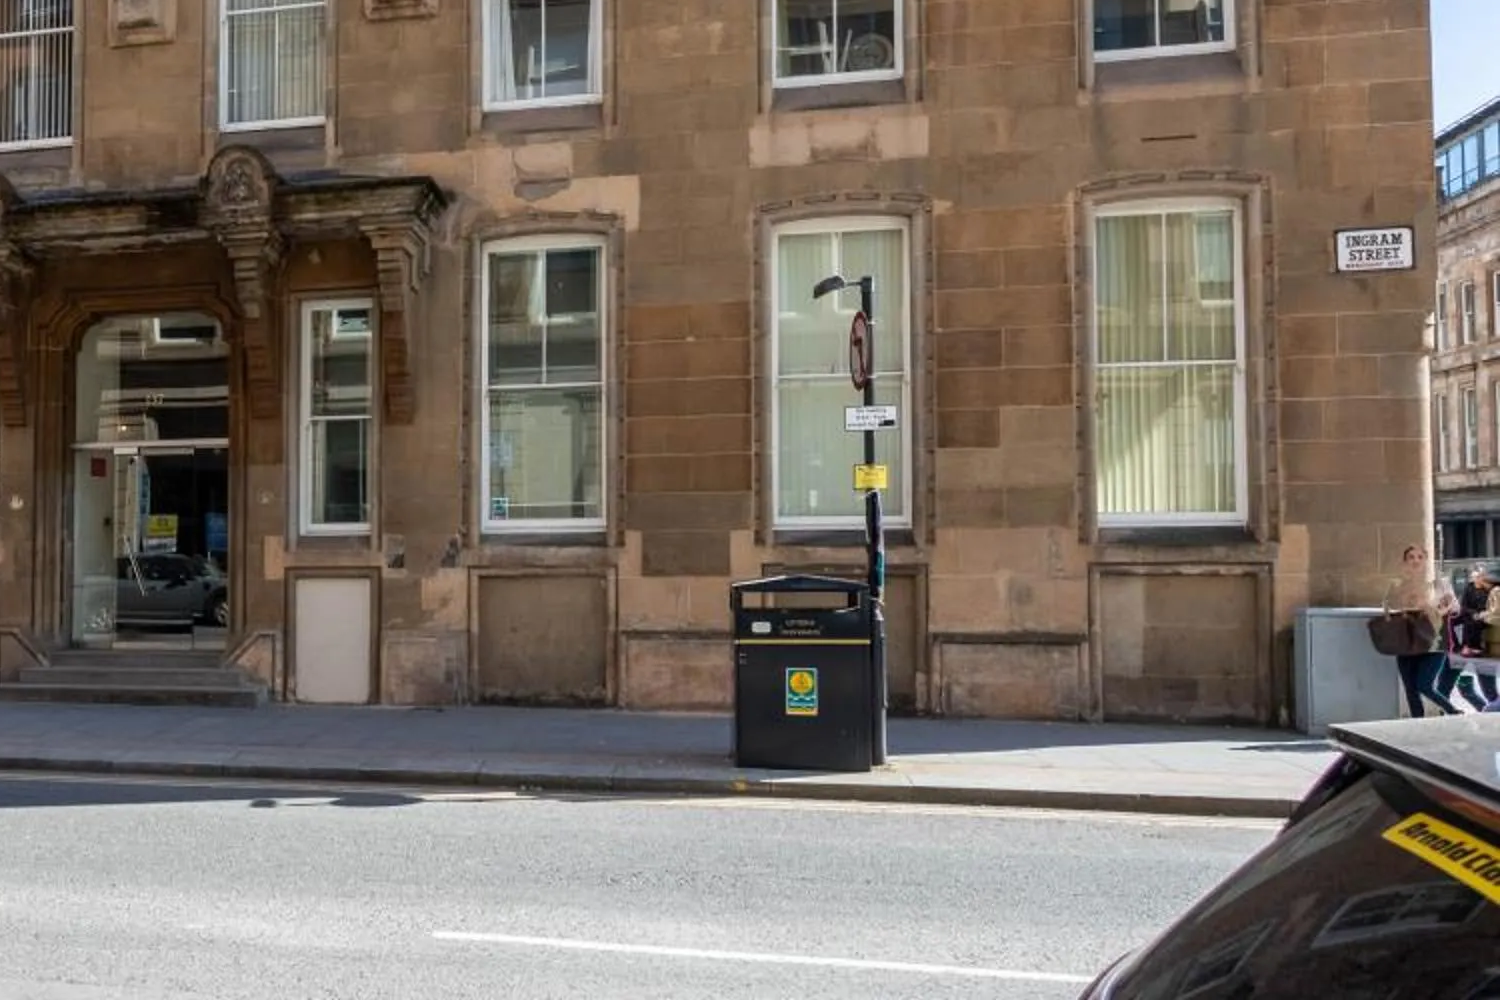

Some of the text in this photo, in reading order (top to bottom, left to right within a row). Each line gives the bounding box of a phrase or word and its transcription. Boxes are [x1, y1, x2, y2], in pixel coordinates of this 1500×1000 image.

[1345, 233, 1403, 247] INGRAM
[1348, 247, 1401, 260] STREET
[1398, 822, 1478, 861] Arnold
